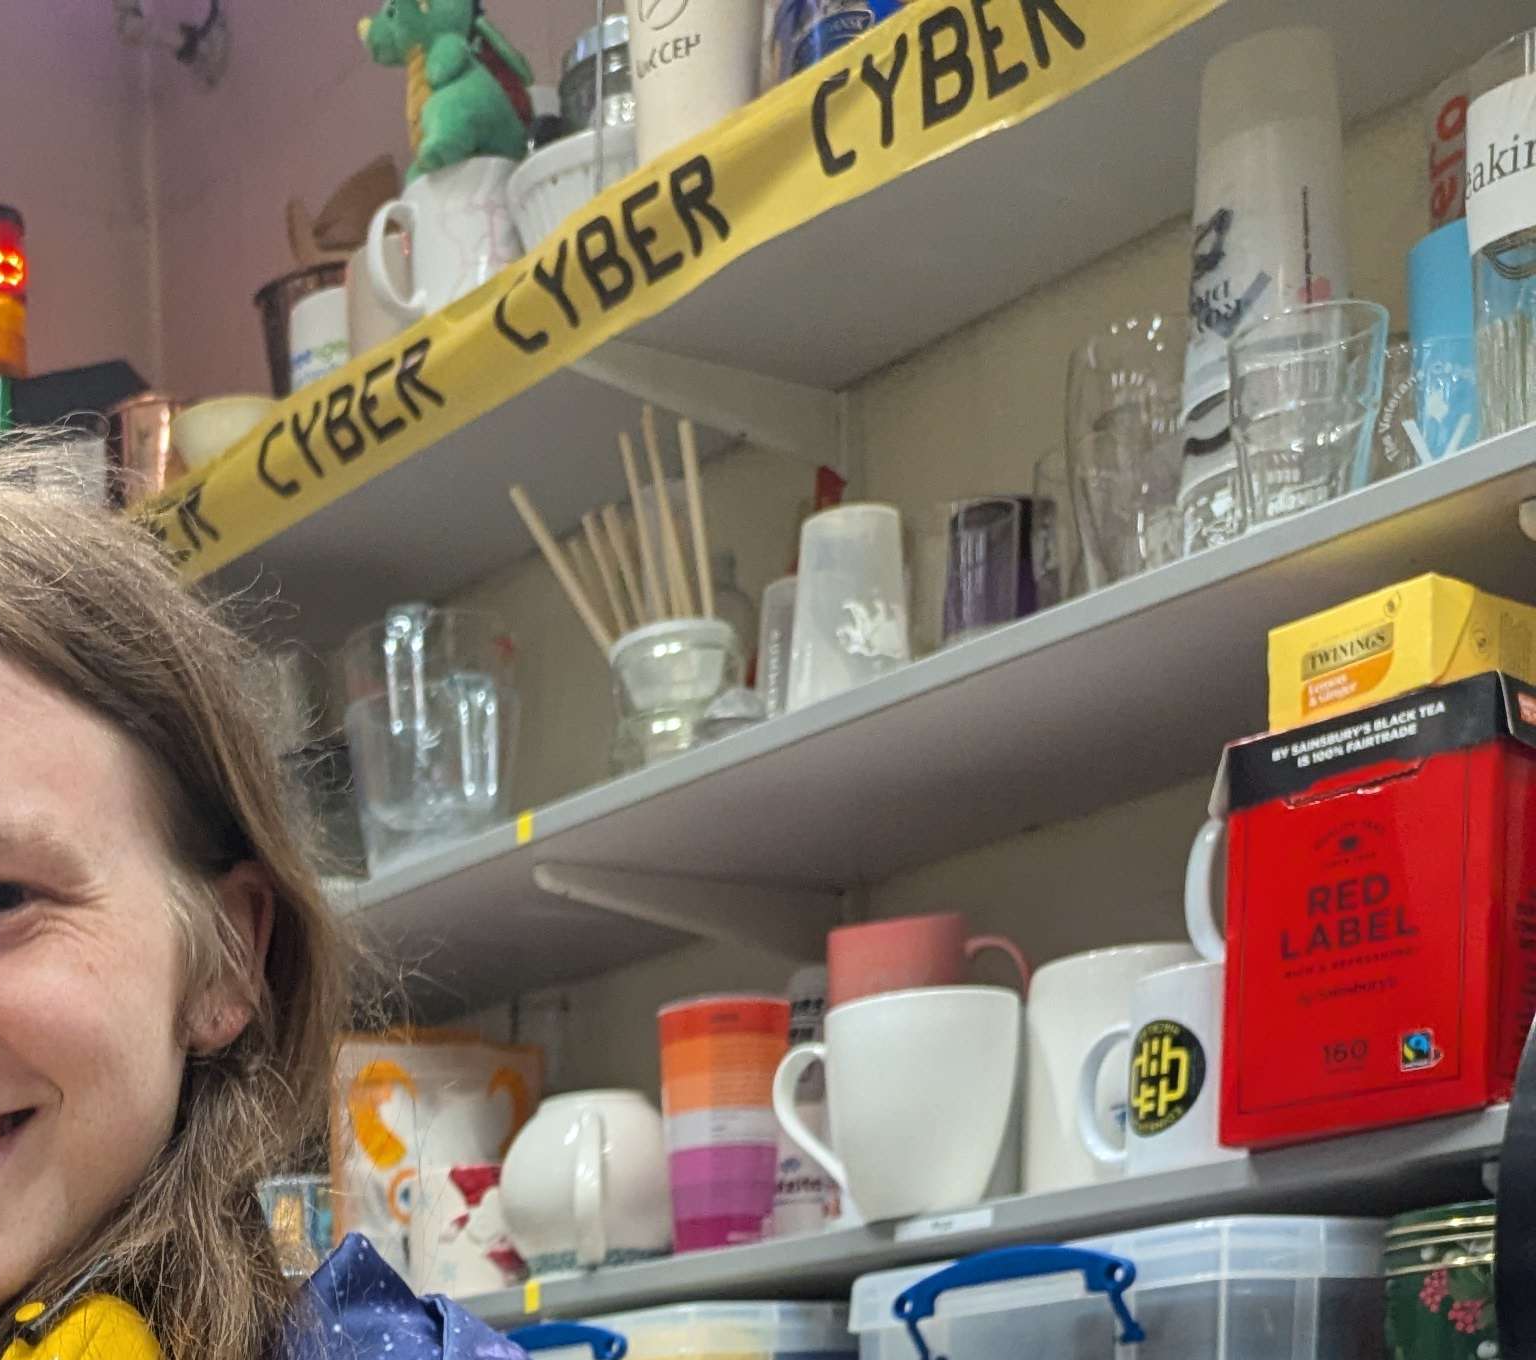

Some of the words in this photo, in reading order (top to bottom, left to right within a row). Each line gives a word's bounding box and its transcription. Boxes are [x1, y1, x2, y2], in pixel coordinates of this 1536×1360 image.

[256, 338, 445, 499] CYBER
[494, 153, 730, 353] CYBER
[810, 0, 1088, 177] CYBER
[1310, 630, 1387, 670] TWININGS
[1271, 746, 1290, 762] BY
[1291, 719, 1373, 757] SAINSBURY'S
[1373, 709, 1419, 731] BLACK
[1419, 701, 1446, 719] TEA
[1297, 754, 1312, 768] IS
[1312, 744, 1345, 765] 100%
[1346, 722, 1418, 753] FAIRTRADE
[1307, 873, 1390, 917] RED
[1280, 908, 1419, 961] LABEL
